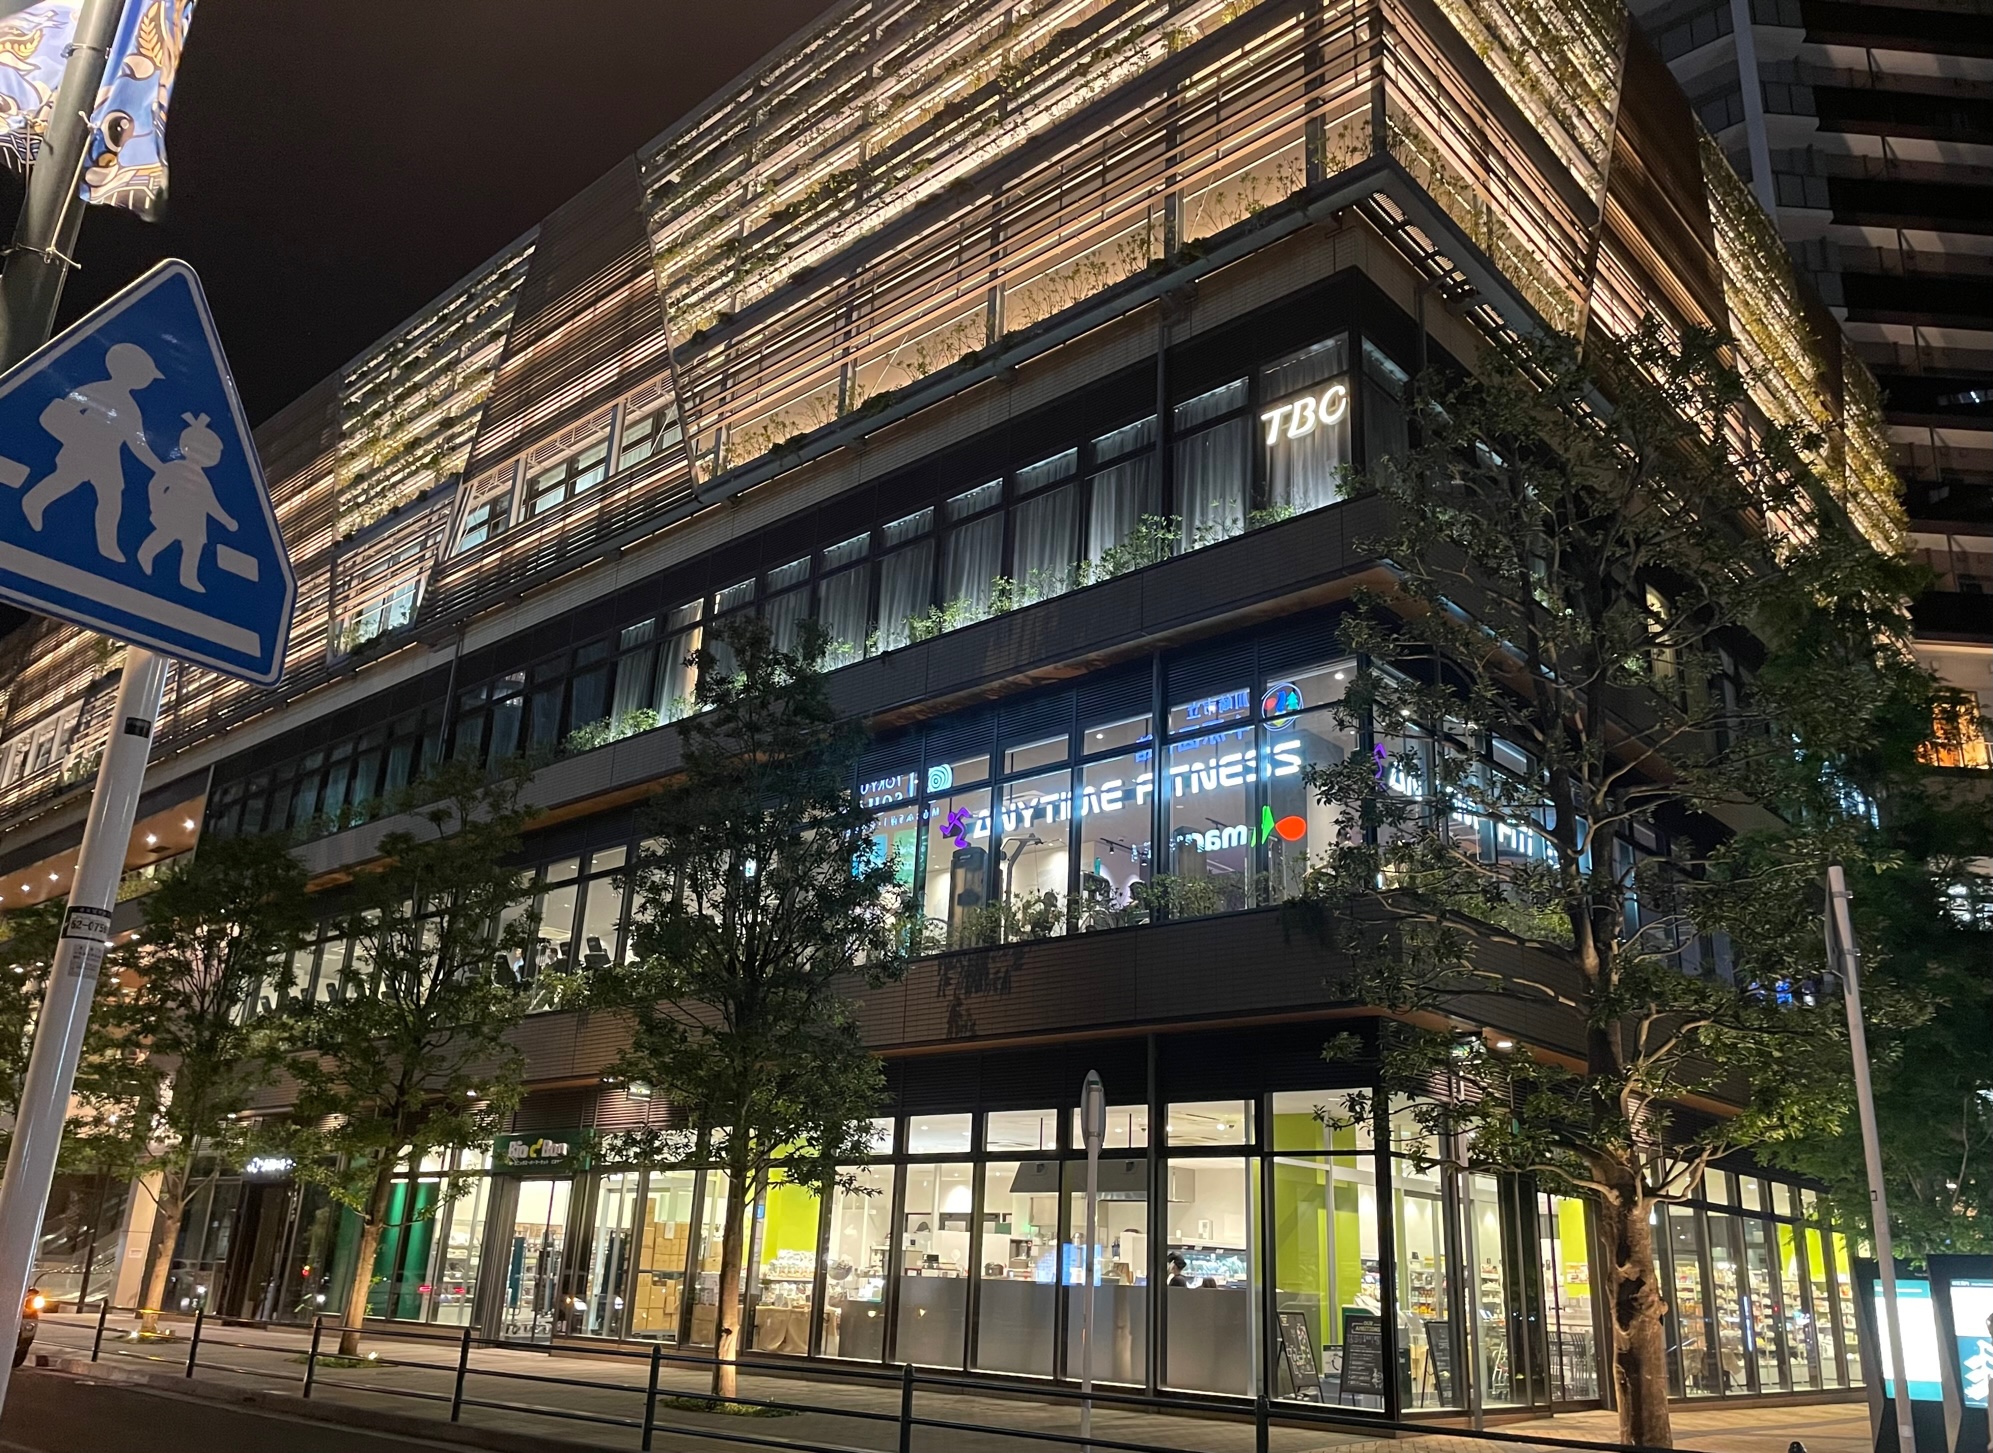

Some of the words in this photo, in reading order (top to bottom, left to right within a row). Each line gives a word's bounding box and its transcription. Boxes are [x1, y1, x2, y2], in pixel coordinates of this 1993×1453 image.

[1261, 385, 1347, 446] TBC
[1136, 740, 1301, 806] FTNESS
[508, 1140, 529, 1158] Bio
[541, 1140, 567, 1157] Bon
